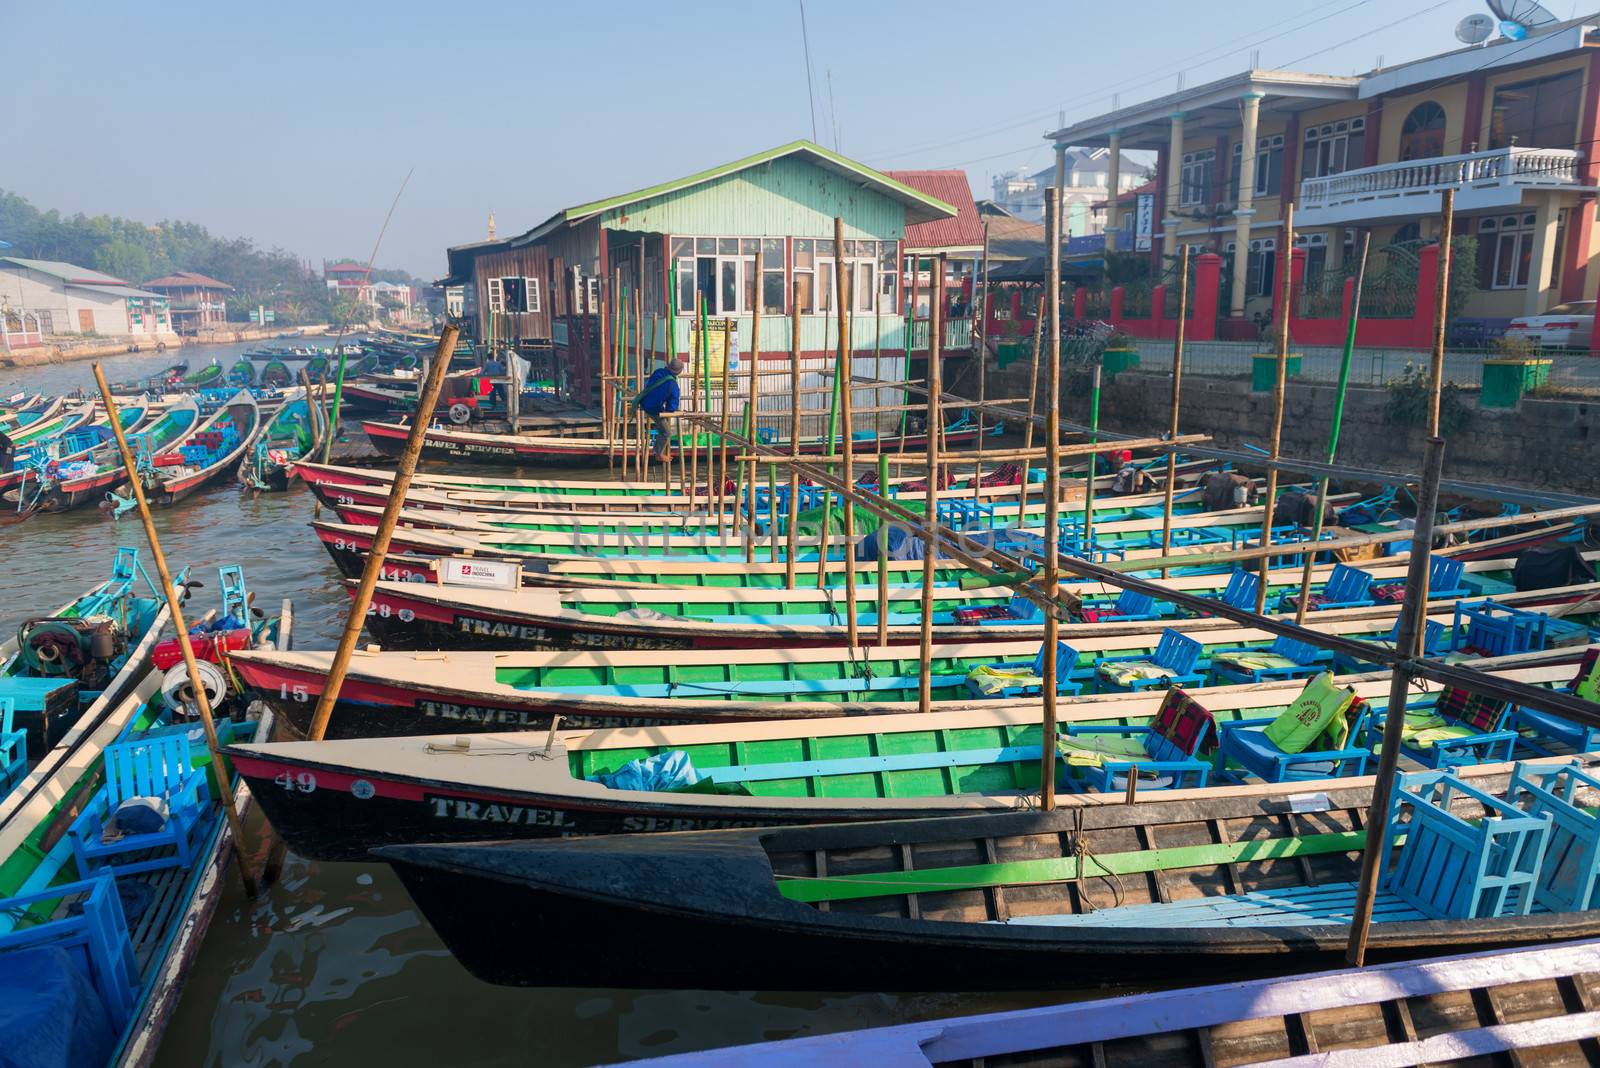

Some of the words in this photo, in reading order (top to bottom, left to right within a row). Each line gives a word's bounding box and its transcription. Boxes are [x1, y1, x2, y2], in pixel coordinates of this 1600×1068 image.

[465, 444, 515, 455] SERVICES
[338, 495, 354, 505] 39
[334, 538, 357, 553] 34
[367, 602, 391, 618] 28
[458, 616, 553, 642] TRAVEL
[279, 682, 309, 703] 15
[419, 700, 537, 726] TRAVEL
[274, 769, 318, 793] 49
[430, 796, 576, 828] TRAVEL
